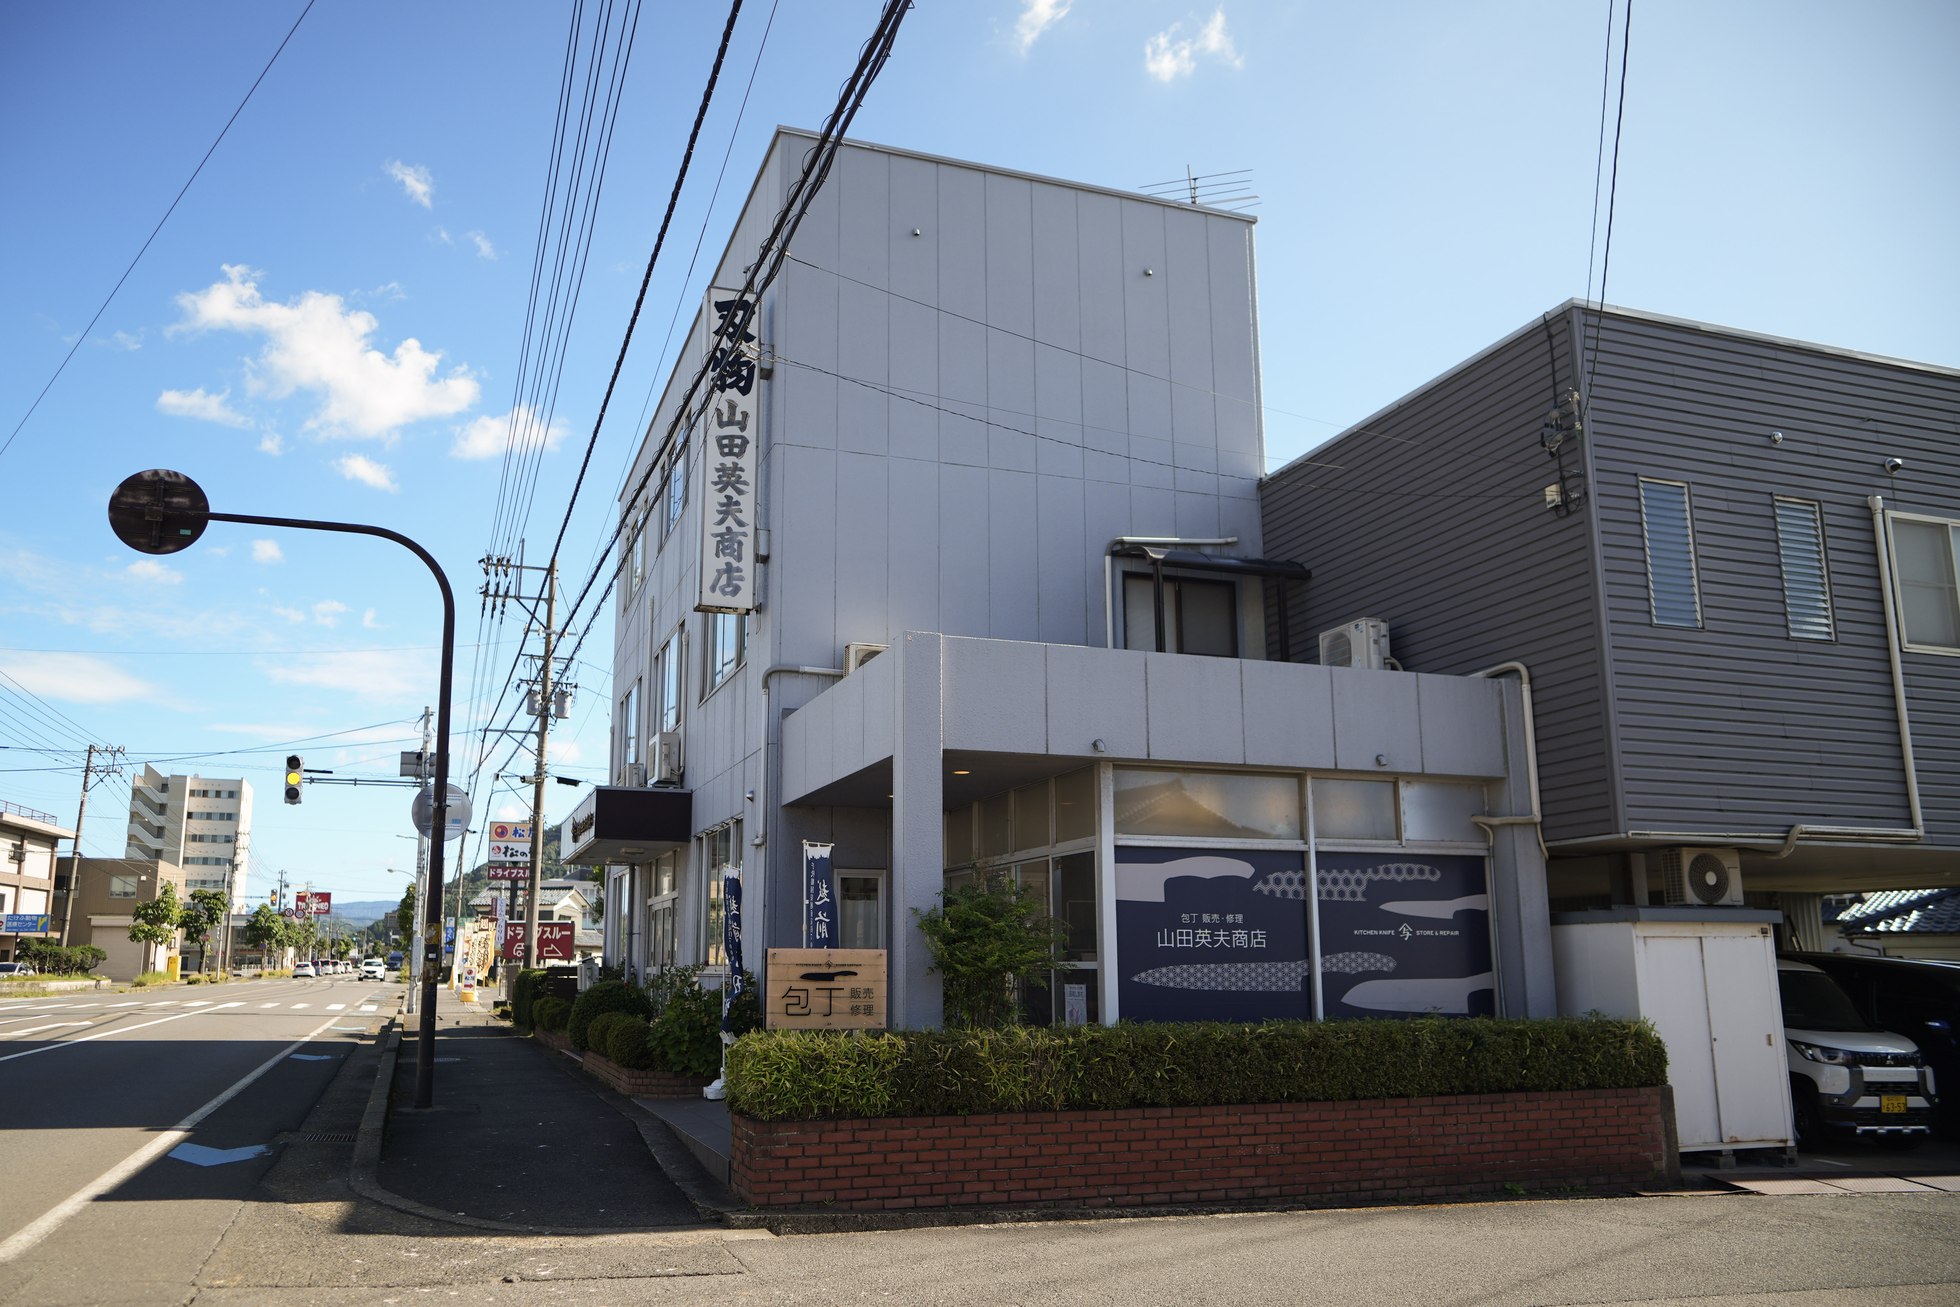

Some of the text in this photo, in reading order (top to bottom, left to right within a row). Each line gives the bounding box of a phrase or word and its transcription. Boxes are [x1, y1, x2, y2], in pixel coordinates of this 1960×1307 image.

[709, 398, 750, 598] 山田英夫商店
[512, 826, 532, 838] 松
[502, 845, 532, 858] 松の
[814, 880, 831, 948] 越前
[1181, 913, 1199, 924] 包丁
[506, 926, 571, 940] ドラブスルー
[1157, 928, 1267, 948] 山田英夫商店
[850, 987, 874, 1000] 販売
[781, 985, 845, 1017] 包丁
[850, 1004, 874, 1017] 修理
